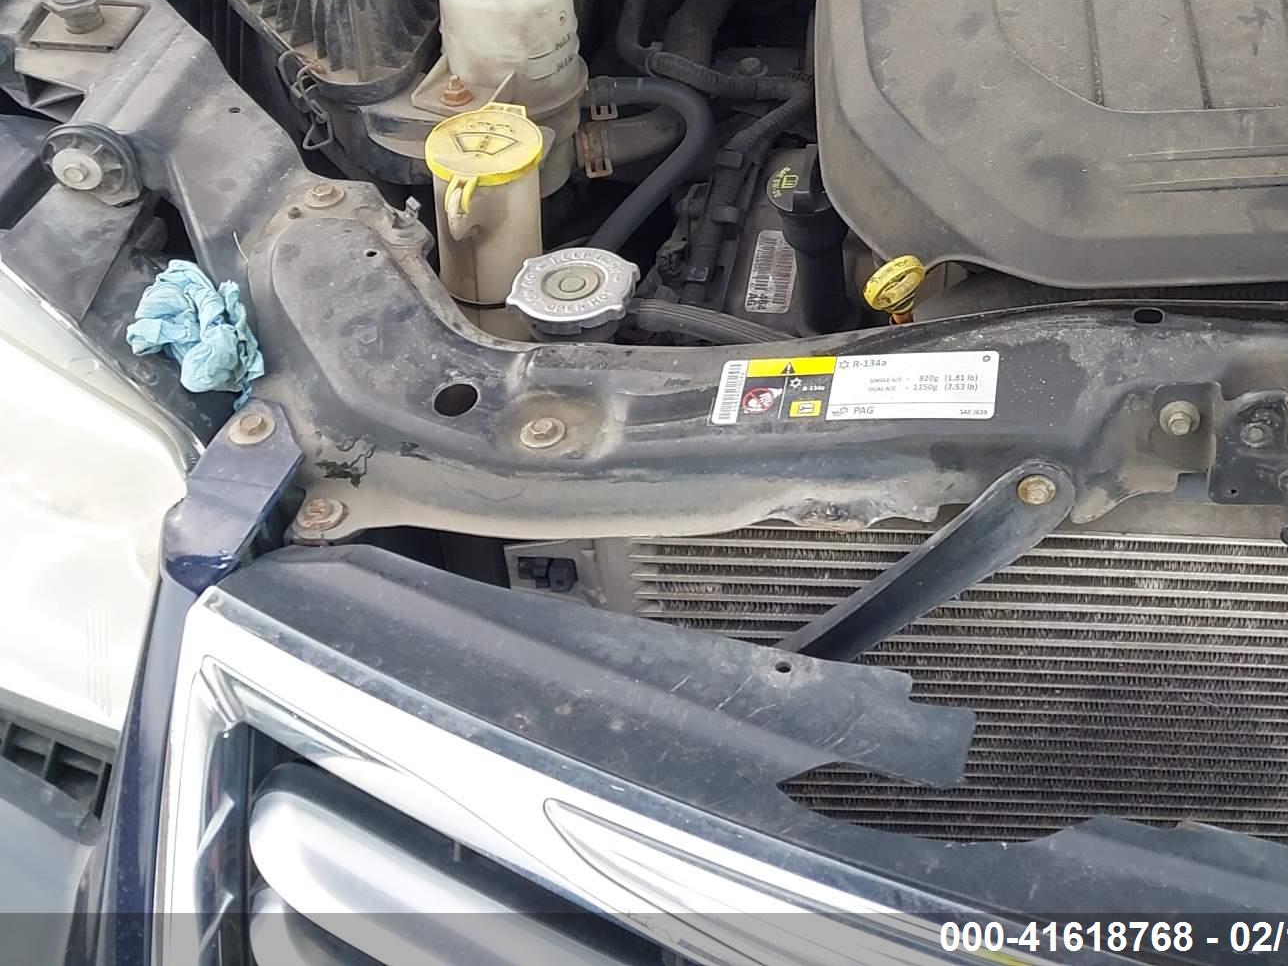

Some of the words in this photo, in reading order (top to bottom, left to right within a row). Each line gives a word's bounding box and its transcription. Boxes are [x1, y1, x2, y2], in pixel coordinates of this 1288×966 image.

[852, 358, 887, 369] R-134a
[919, 375, 940, 383] 820g
[912, 384, 938, 393] 1150g
[853, 407, 875, 415] PAG
